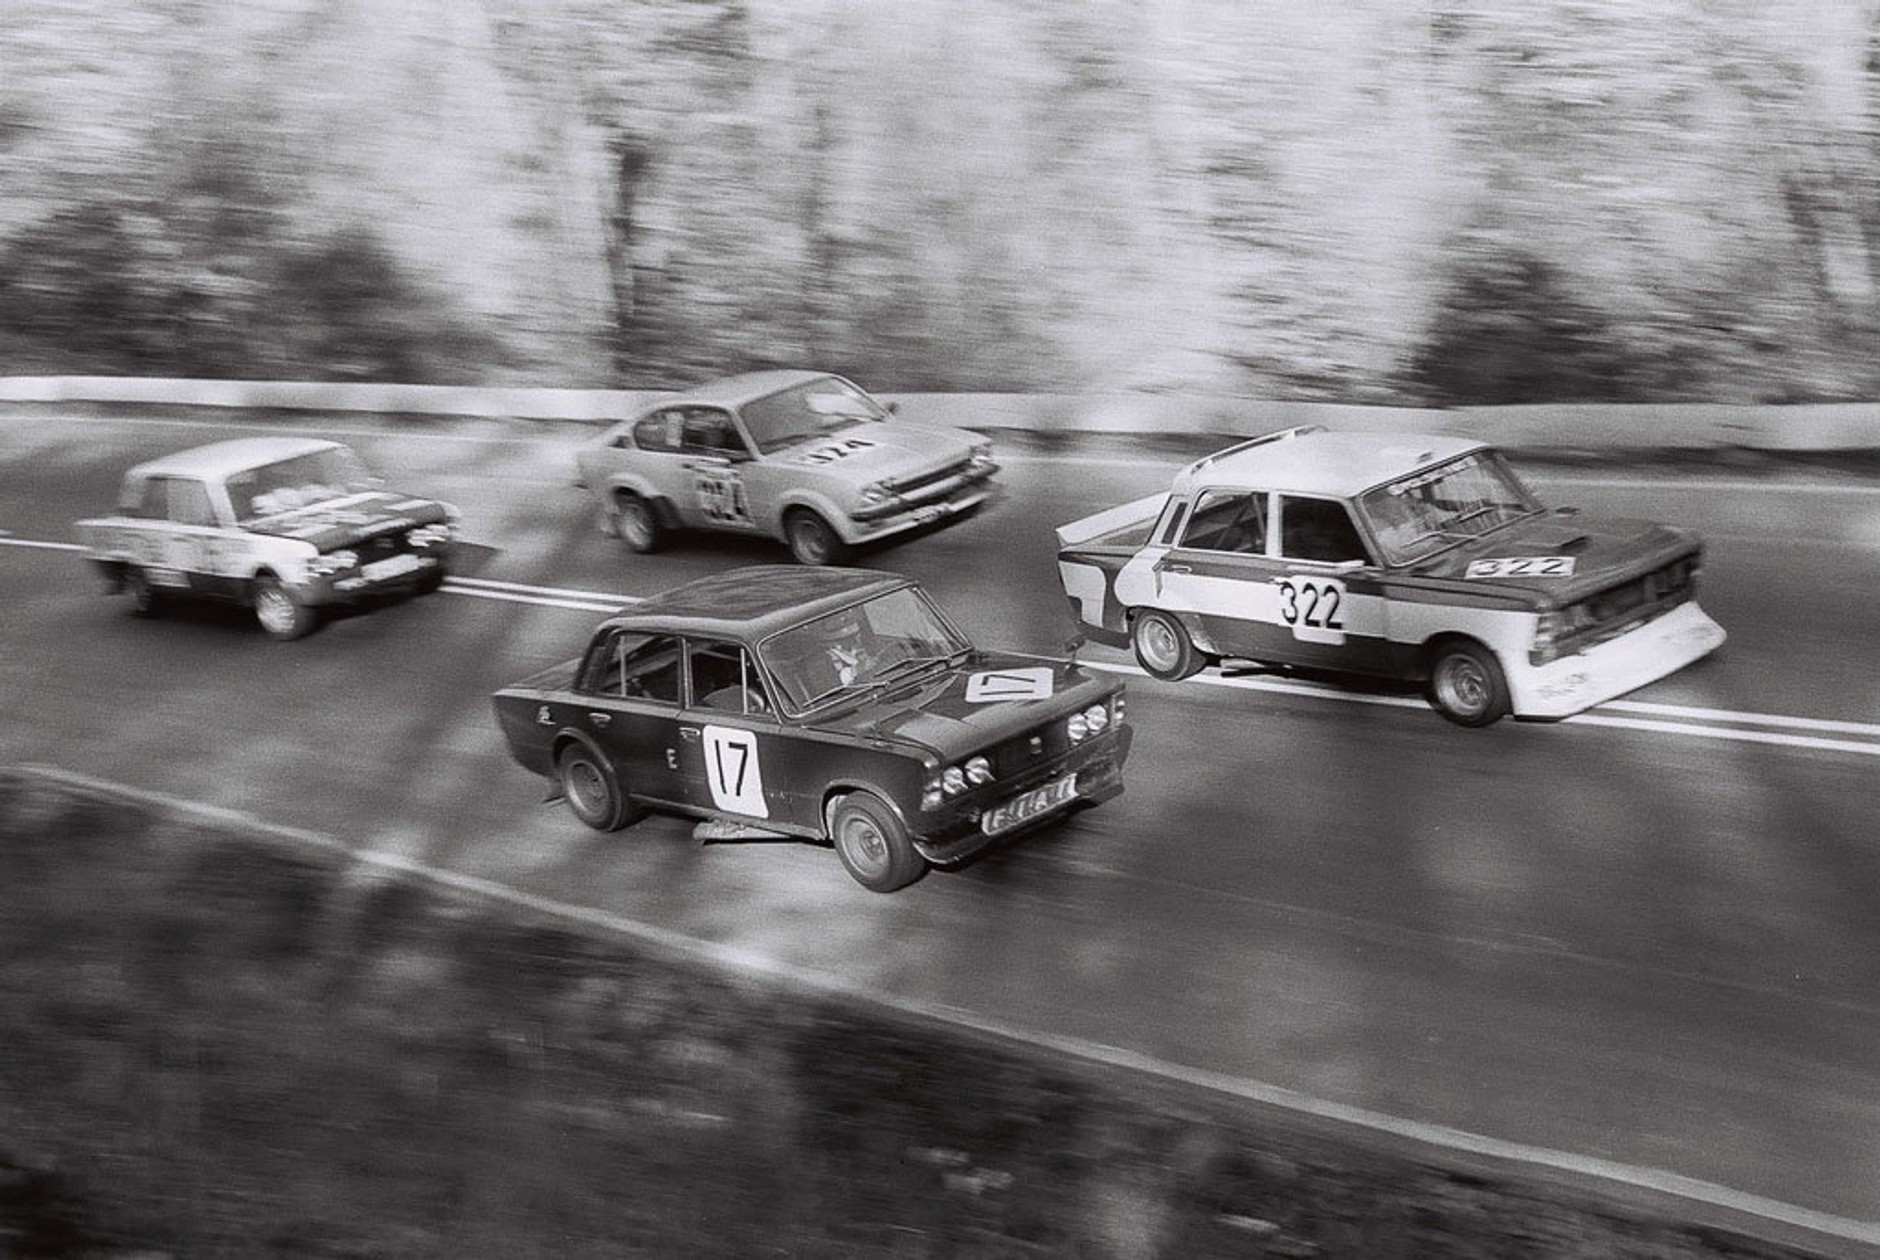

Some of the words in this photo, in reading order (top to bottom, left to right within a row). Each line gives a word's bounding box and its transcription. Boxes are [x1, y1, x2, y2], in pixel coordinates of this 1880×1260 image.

[1473, 557, 1565, 576] 322
[1279, 581, 1343, 630] 322
[979, 673, 1036, 696] 17
[714, 739, 748, 797] 17
